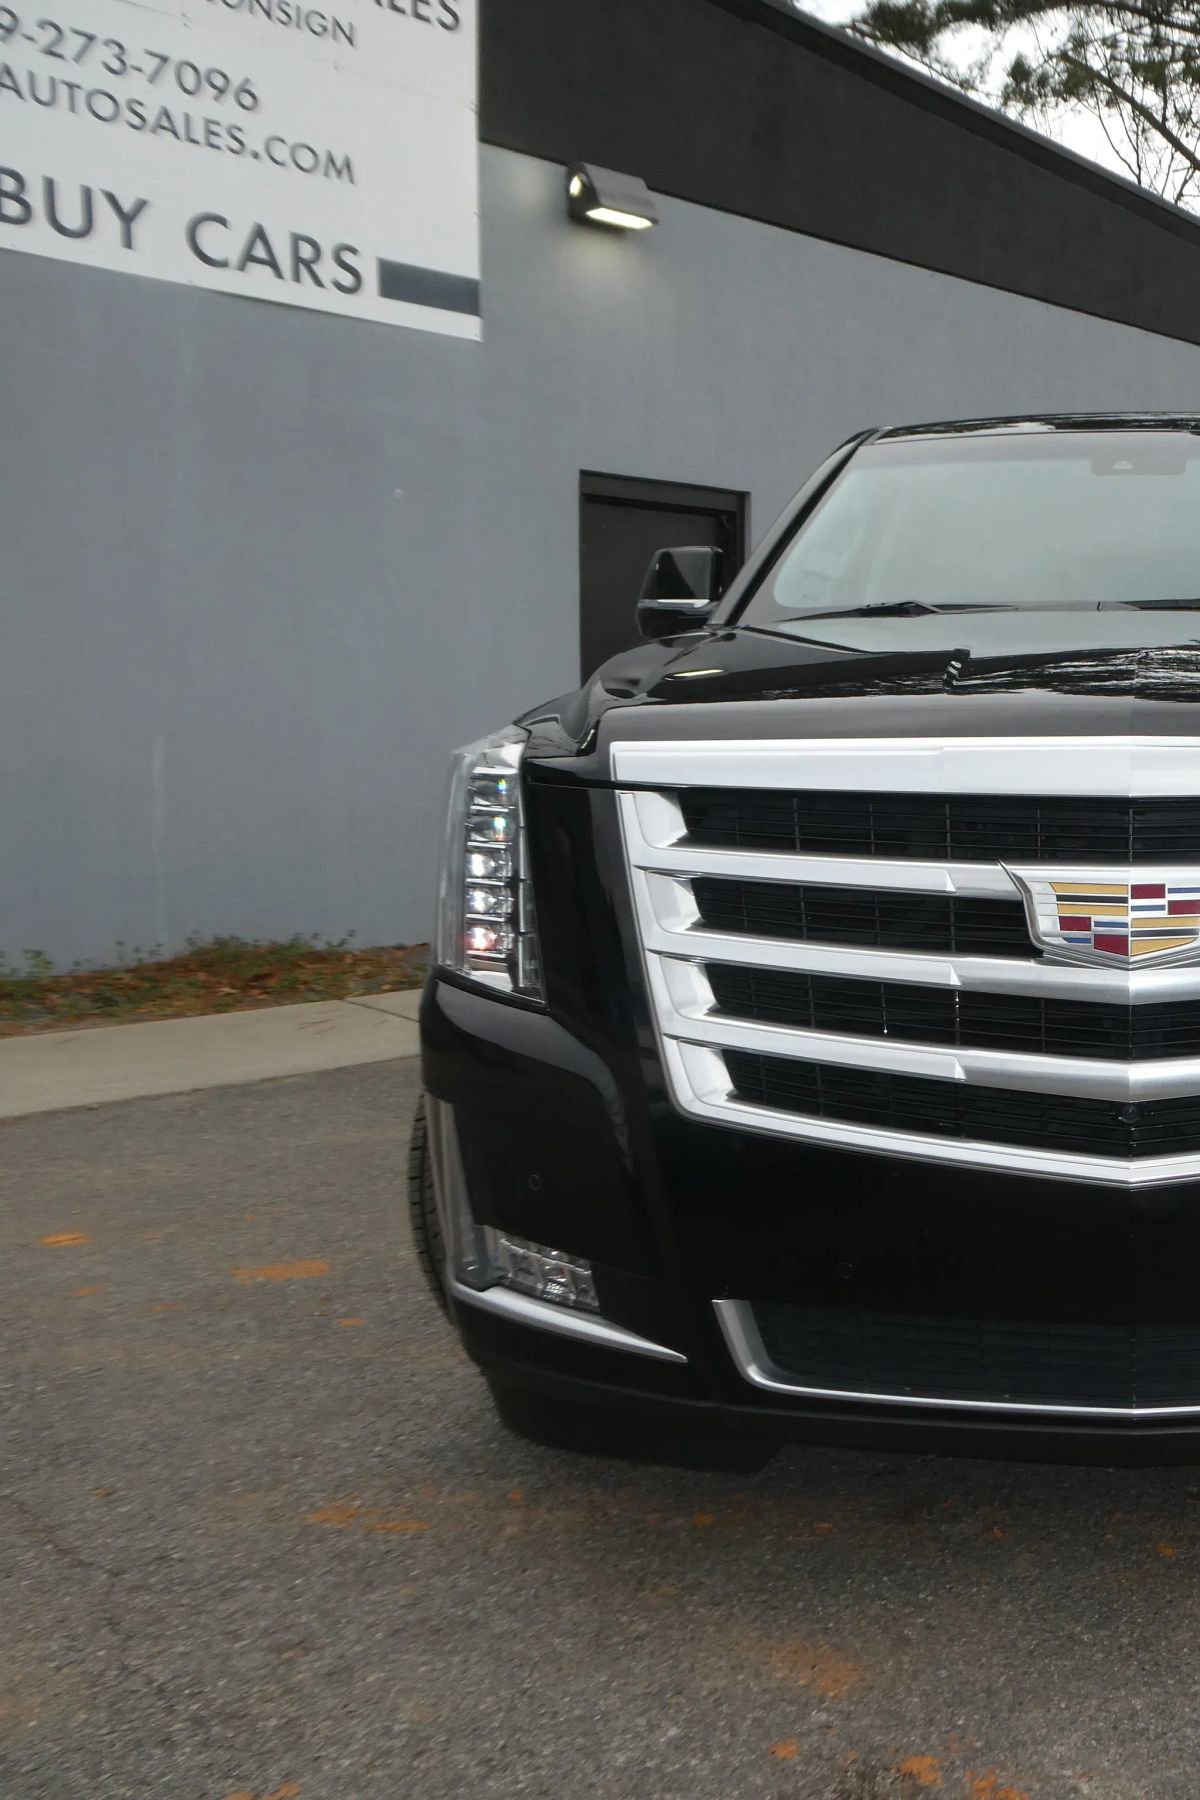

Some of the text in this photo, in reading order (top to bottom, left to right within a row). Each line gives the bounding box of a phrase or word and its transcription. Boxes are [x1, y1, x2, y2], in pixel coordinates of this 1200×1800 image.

[0, 6, 259, 111] 9-273-7096
[0, 62, 356, 185] AUTOSALES.COM
[0, 165, 363, 295] BUY CARS
